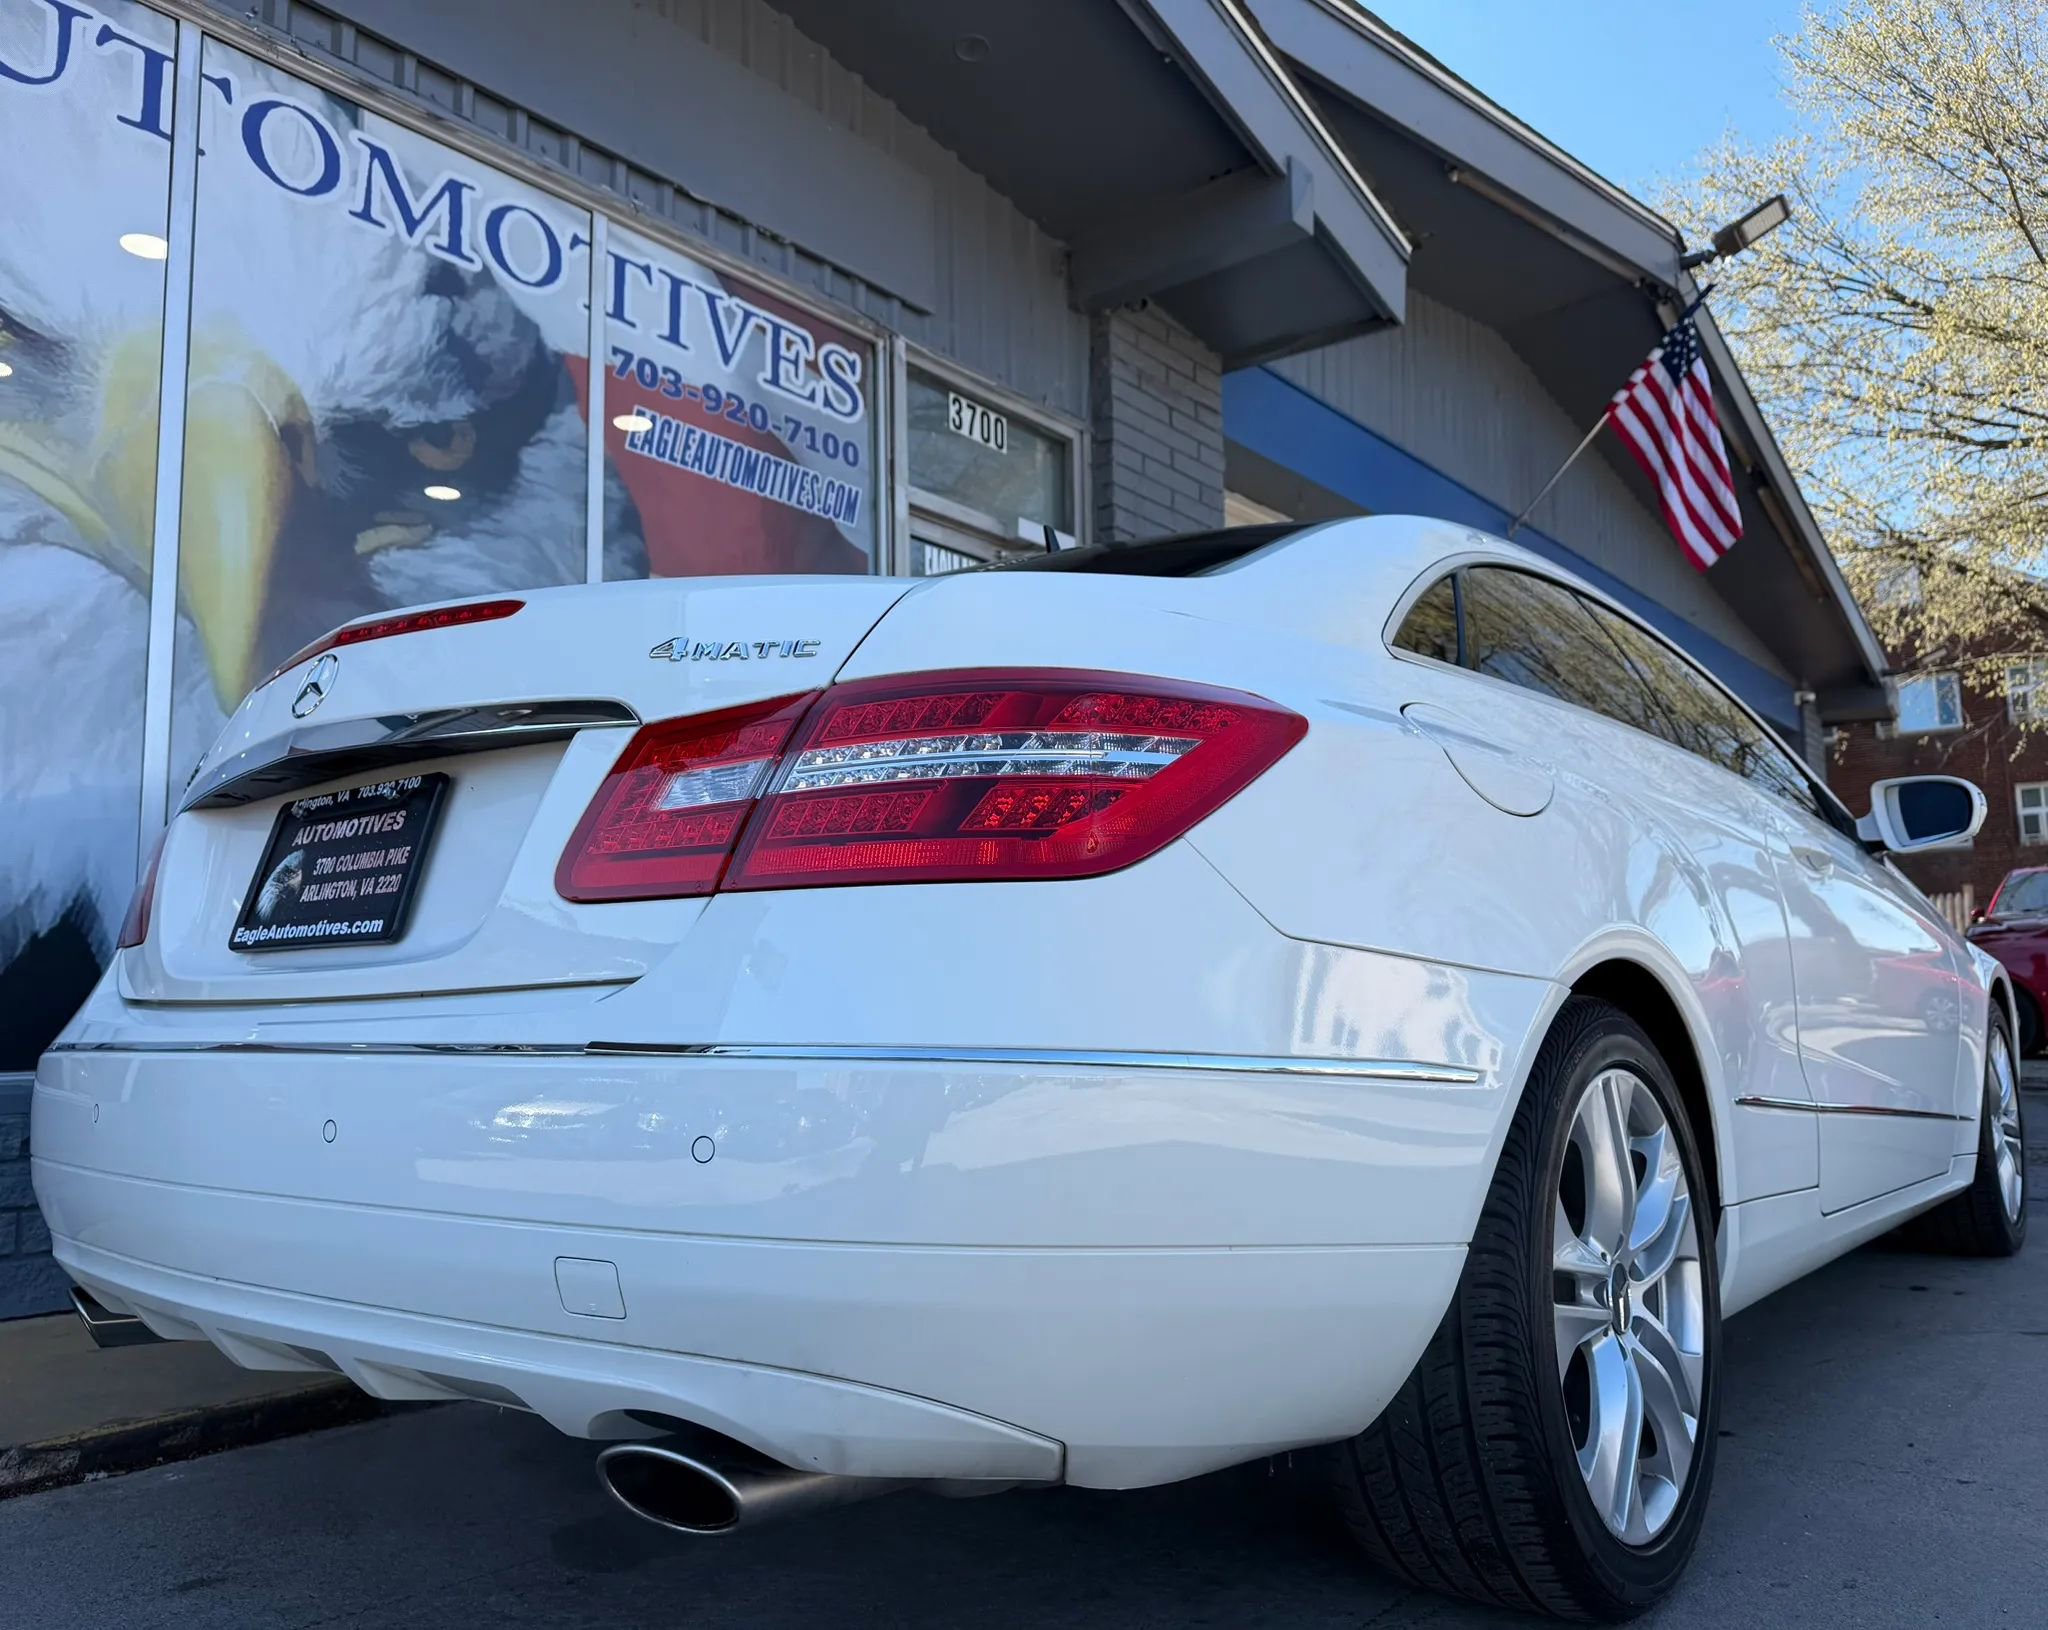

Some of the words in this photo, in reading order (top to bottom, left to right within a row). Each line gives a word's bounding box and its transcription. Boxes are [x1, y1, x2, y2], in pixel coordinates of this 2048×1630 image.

[611, 345, 861, 468] 703-920-7100
[951, 396, 1005, 451] 3700
[626, 406, 861, 524] EAGLEAUTOMOTIVES.COM
[649, 636, 822, 662] 4MATIC
[337, 790, 350, 803] VA
[292, 810, 407, 847] AUTOMOTIVES
[313, 856, 337, 876] 3700
[336, 849, 386, 873] COLUMBIA
[384, 846, 412, 867] PIKE
[300, 879, 358, 902] ARLINGTON,
[360, 877, 376, 896] VA
[375, 874, 402, 894] 2220
[233, 919, 384, 945] EagleAutomotives.com
